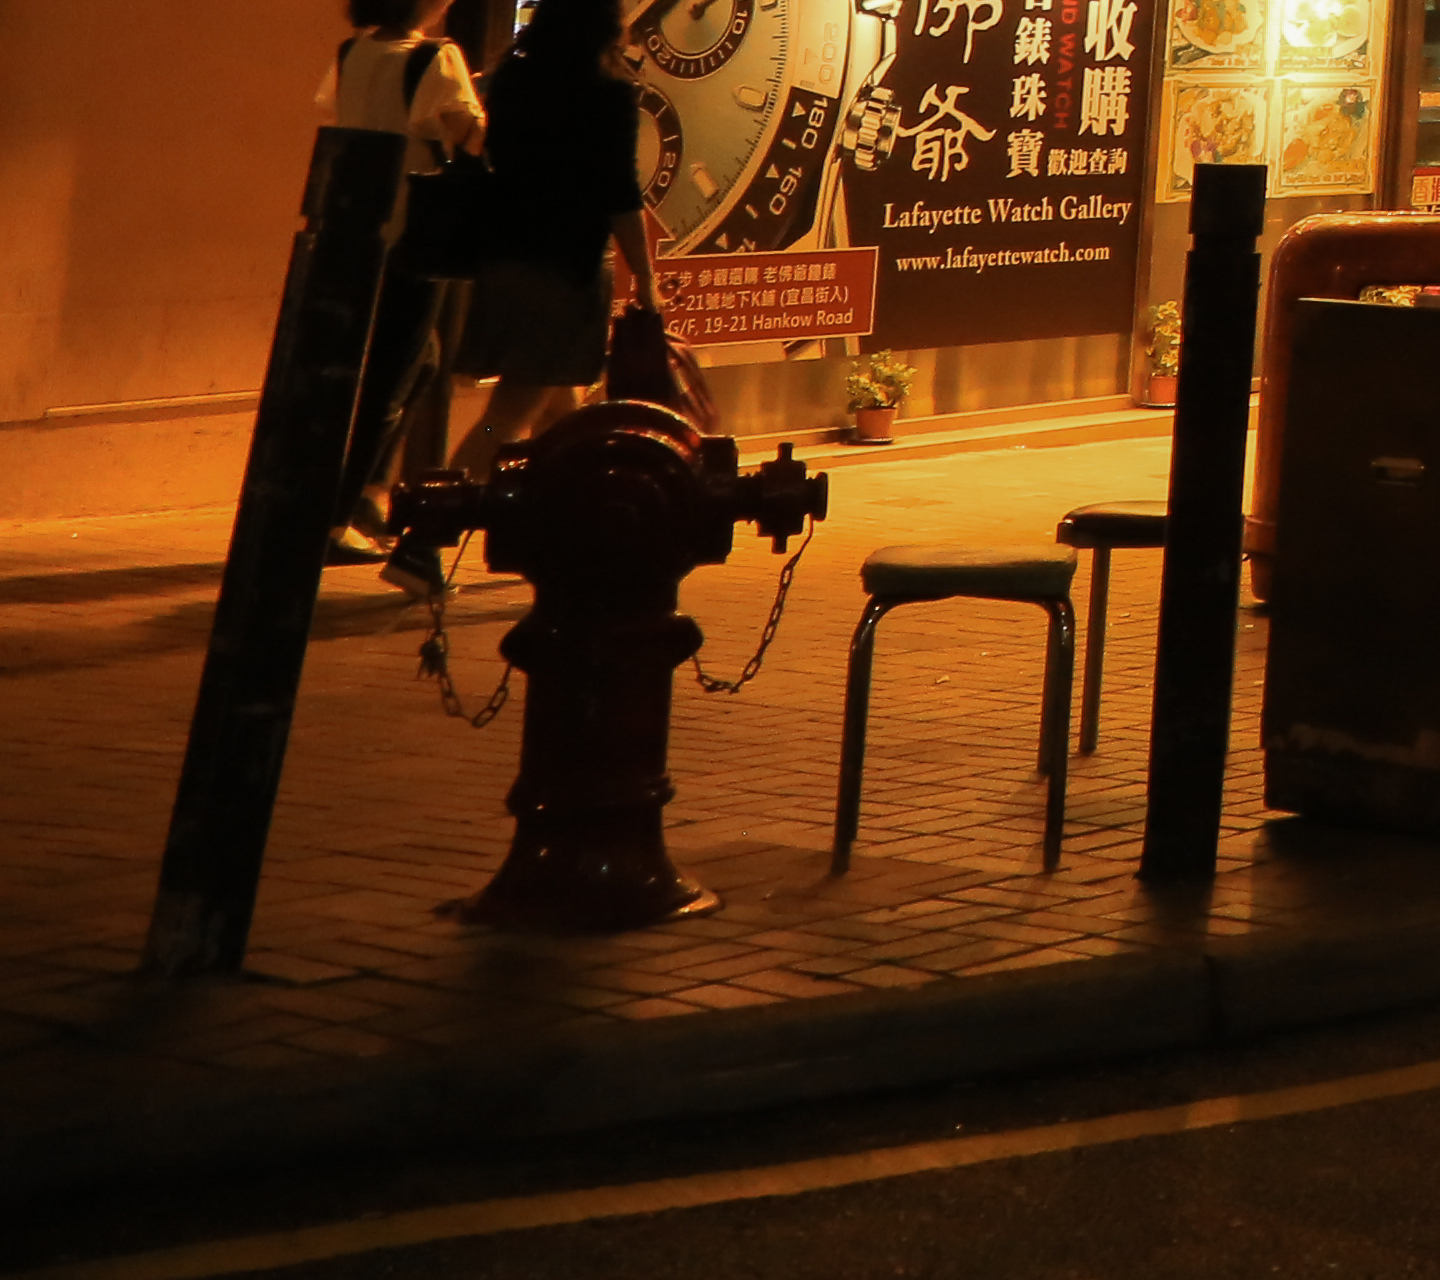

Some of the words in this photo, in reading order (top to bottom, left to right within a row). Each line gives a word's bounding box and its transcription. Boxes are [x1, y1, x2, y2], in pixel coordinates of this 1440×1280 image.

[1053, 32, 1077, 130] WATCH
[801, 97, 829, 150] 180
[1047, 146, 1128, 177] 歡迎查詢
[768, 166, 802, 216] 160
[882, 201, 983, 234] Lafayette
[988, 197, 1053, 223] Watch
[1060, 194, 1132, 225] Gallery
[896, 242, 1111, 274] www.lafayettewatch.com
[704, 314, 748, 333] 19-21
[752, 312, 812, 331] Hankow
[815, 308, 854, 326] Road
